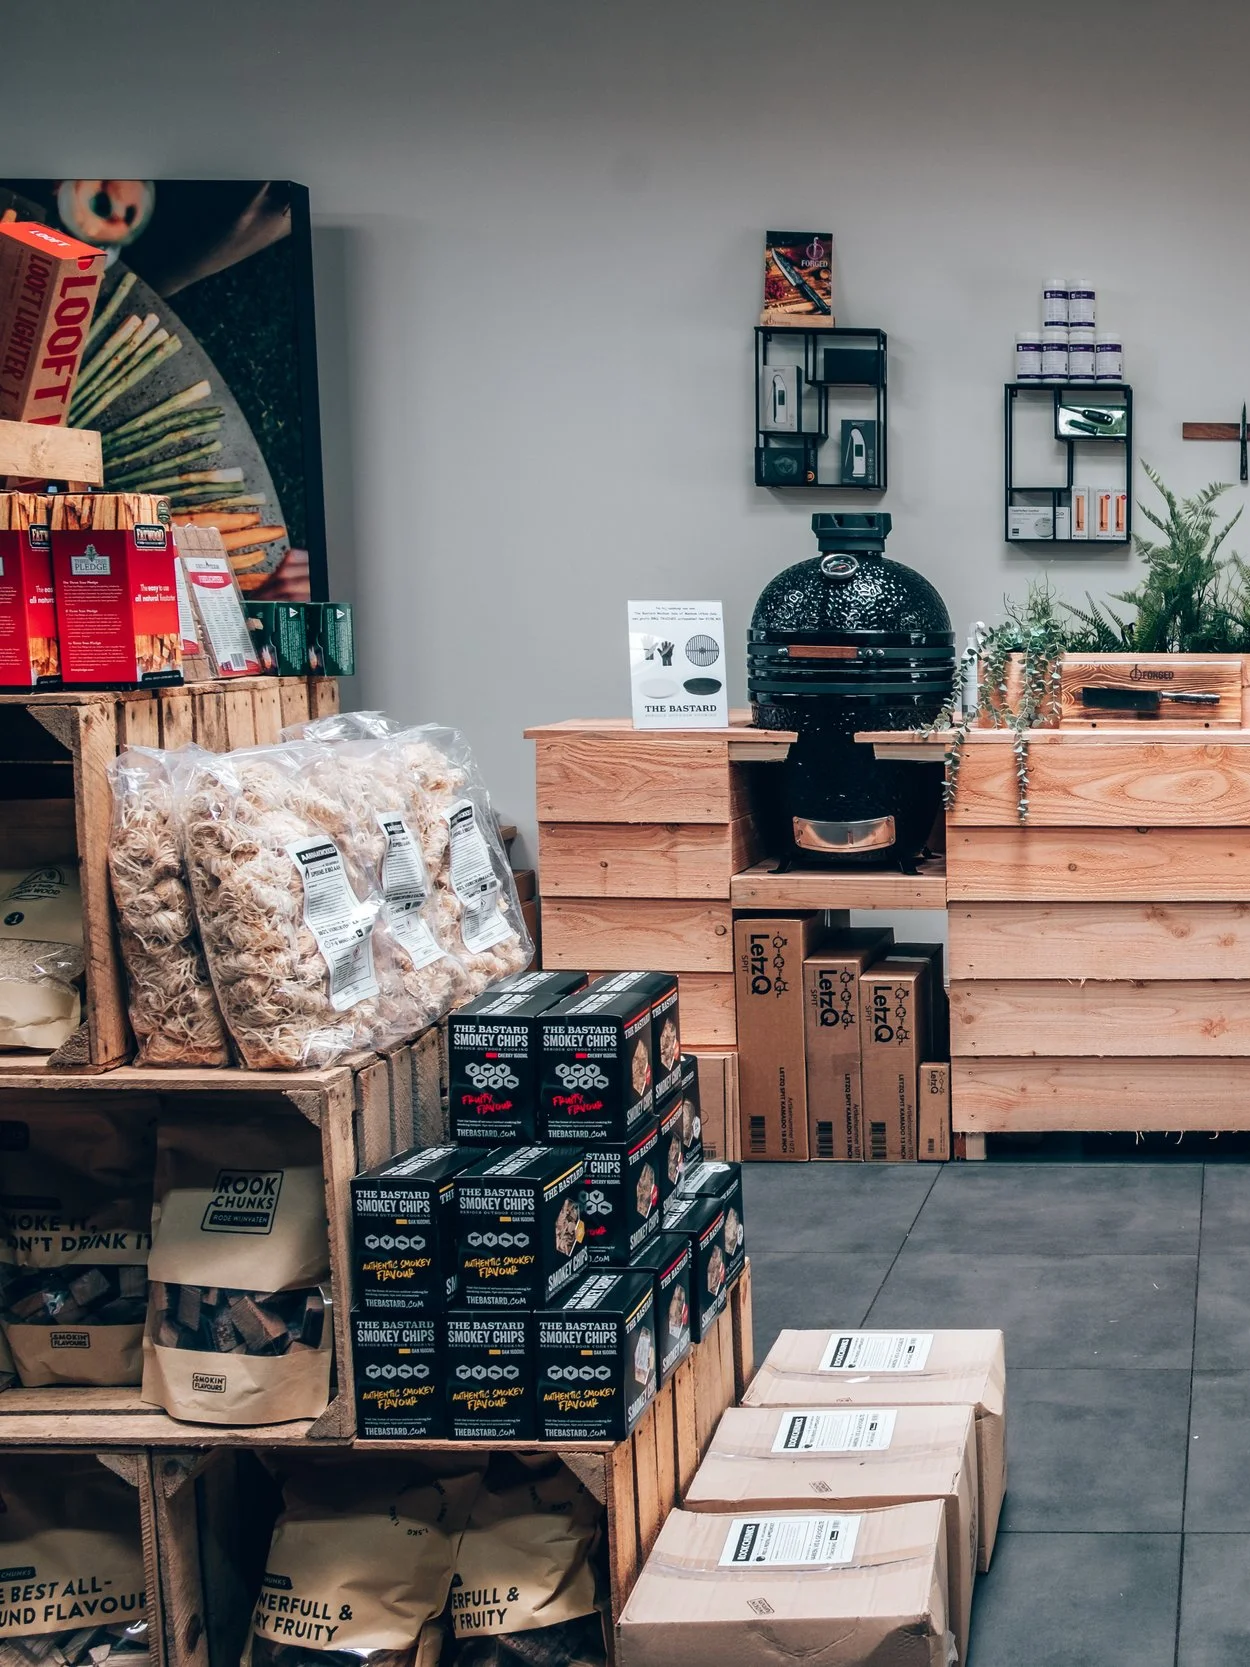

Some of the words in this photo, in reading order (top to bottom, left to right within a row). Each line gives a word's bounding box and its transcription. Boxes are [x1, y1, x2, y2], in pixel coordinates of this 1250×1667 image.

[29, 230, 70, 247] LOOFT
[800, 259, 828, 268] FORGED
[20, 253, 52, 311] LOOFT
[3, 308, 39, 379] LIGHTER
[33, 274, 98, 405] LOOFT
[136, 528, 165, 542] FATWOOD
[74, 563, 108, 571] PLEDGE
[148, 585, 159, 594] easy
[134, 594, 142, 602] all
[1142, 670, 1174, 680] FORGED
[645, 705, 666, 713] THE
[669, 704, 717, 712] BASTARD
[750, 934, 772, 996] LetzQ
[810, 989, 818, 1007] SPIT
[819, 969, 840, 1027] LetzQ
[864, 1005, 872, 1022] SPIT
[873, 985, 894, 1043] LetzQ
[453, 1024, 476, 1033] THE
[479, 1025, 529, 1034] BASTARD
[543, 1026, 565, 1034] THE
[568, 1025, 617, 1034] BASTARD
[453, 1033, 495, 1047] SMOKEY
[497, 1034, 529, 1047] CHIPS
[543, 1034, 585, 1047] SMOKEY
[586, 1034, 617, 1047] CHIPS
[930, 1070, 938, 1094] LetzQ
[640, 1133, 658, 1156] BASTARD
[590, 1161, 621, 1174] CHIPS
[218, 1176, 278, 1195] ROOK
[543, 1185, 558, 1202] THE
[558, 1167, 583, 1193] BASTARD
[355, 1190, 380, 1199] THE
[382, 1190, 430, 1200] BASTARD
[458, 1188, 483, 1197] THE
[485, 1188, 535, 1197] BASTARD
[214, 1195, 274, 1210] CHUNKS
[356, 1199, 396, 1213] SMOKEY
[399, 1200, 431, 1213] CHIPS
[459, 1197, 500, 1210] SMOKEY
[503, 1197, 535, 1210] CHIPS
[5, 1214, 61, 1232] MOKE
[69, 1214, 97, 1233] IT,
[213, 1214, 232, 1222] RODE
[62, 1232, 126, 1252] DRINK
[629, 1221, 648, 1251] SMOKEY
[362, 1260, 398, 1272] AUTHENTIC
[399, 1257, 432, 1268] SMOKEY
[464, 1258, 501, 1269] AUTHENTIC
[503, 1255, 536, 1265] SMOKEY
[548, 1262, 572, 1292] SMOKEY
[572, 1246, 589, 1273] CHIPS
[376, 1269, 416, 1281] FLAVOUR
[478, 1265, 519, 1279] FLAVOUR
[701, 1300, 719, 1328] SMOKEY
[356, 1320, 381, 1329] THE
[382, 1320, 435, 1329] BASTARD
[447, 1321, 471, 1330] THE
[473, 1321, 525, 1330] BASTARD
[539, 1321, 564, 1330] THE
[565, 1322, 617, 1330] BASTARD
[357, 1329, 400, 1343] SMOKEY
[402, 1329, 435, 1342] CHIPS
[448, 1330, 490, 1343] SMOKEY
[493, 1330, 525, 1343] CHIPS
[539, 1330, 582, 1344] SMOKEY
[584, 1330, 618, 1344] CHIPS
[662, 1345, 679, 1374] SMOKEY
[194, 1382, 223, 1391] FLAVOURS
[195, 1375, 224, 1384] SMOKIN'
[362, 1388, 400, 1400] AUTHENTIC
[402, 1385, 435, 1397] SMOKEY
[452, 1389, 491, 1401] AUTHENTIC
[492, 1386, 525, 1398] SMOKEY
[543, 1389, 582, 1402] AUTHENTIC
[583, 1387, 616, 1399] SMOKEY
[378, 1396, 418, 1410] FLAVOUR
[467, 1397, 507, 1411] FLAVOUR
[558, 1398, 599, 1412] FLAVOUR
[627, 1396, 647, 1422] SMOKEY
[1, 1569, 32, 1578] CHUNKS
[11, 1582, 58, 1603] BEST
[62, 1580, 112, 1597] ALL-
[506, 1587, 520, 1602] &
[338, 1604, 353, 1621] &
[460, 1608, 508, 1630] FRUITY
[274, 1617, 339, 1642] FRUITY
